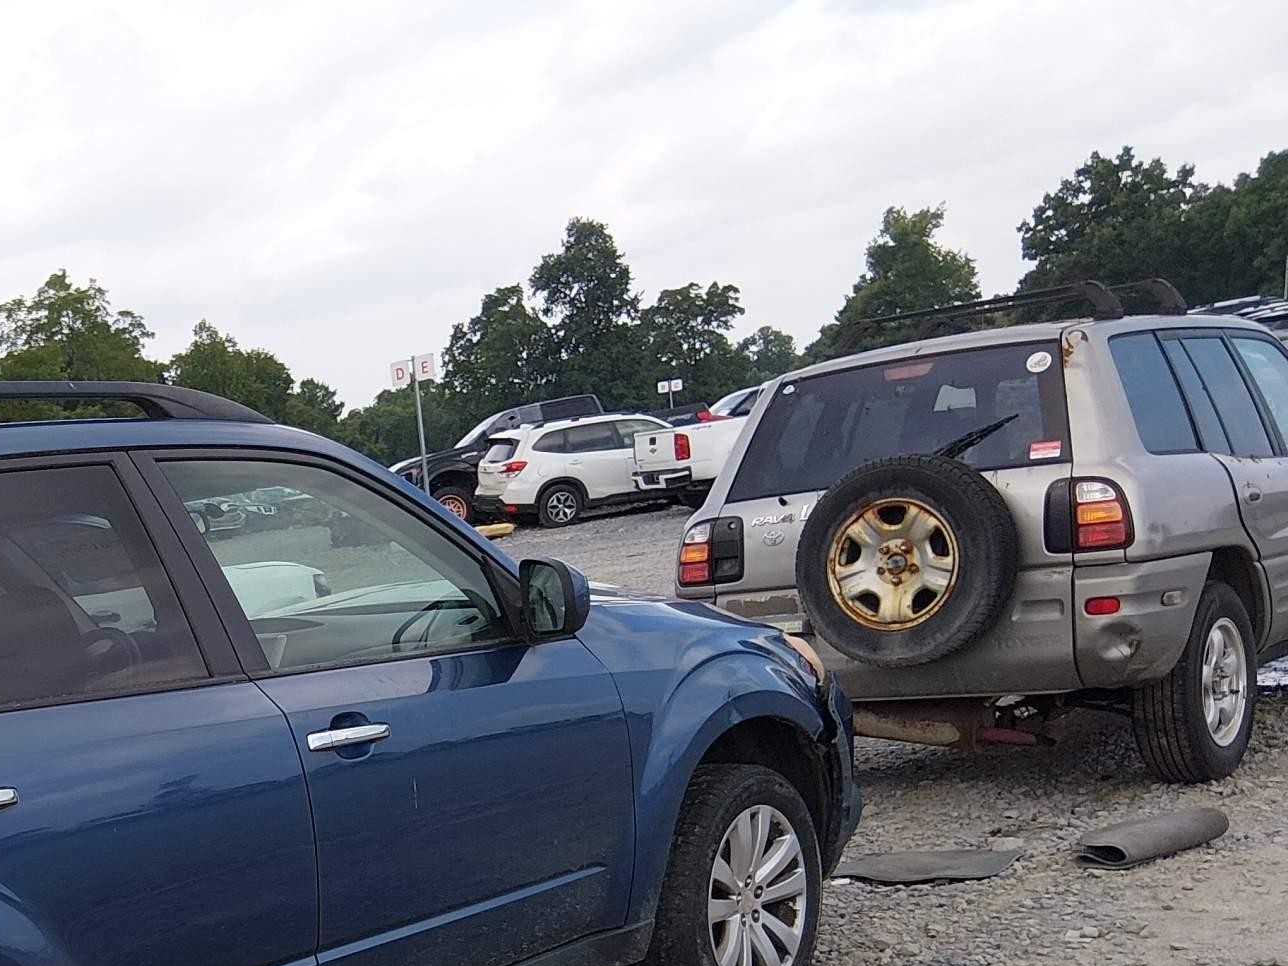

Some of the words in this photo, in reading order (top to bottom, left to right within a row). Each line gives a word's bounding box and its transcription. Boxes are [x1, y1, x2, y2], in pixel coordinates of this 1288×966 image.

[395, 367, 405, 380] D
[420, 360, 429, 374] E
[751, 513, 795, 528] RAV4
